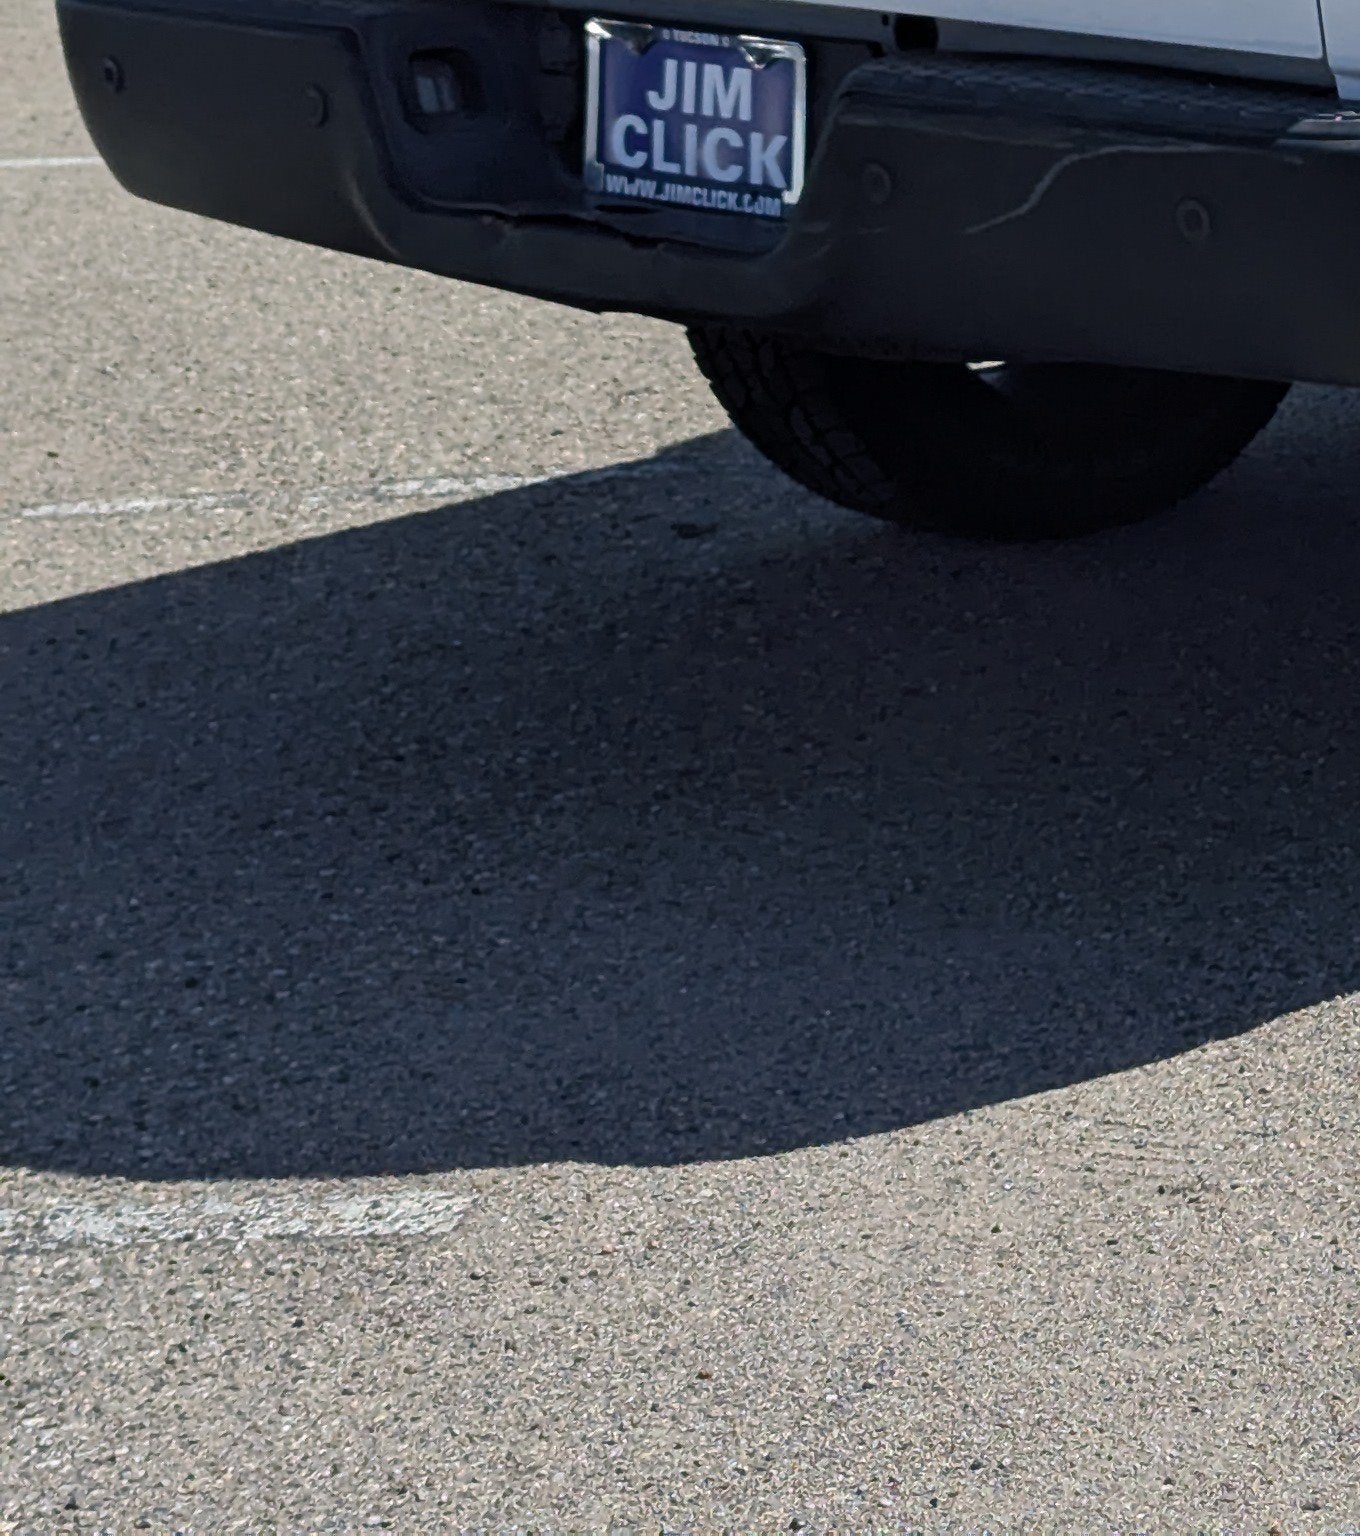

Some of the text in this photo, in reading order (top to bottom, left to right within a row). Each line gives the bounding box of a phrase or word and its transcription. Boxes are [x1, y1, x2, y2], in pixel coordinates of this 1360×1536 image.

[646, 58, 752, 121] JIM
[611, 114, 787, 189] CLICK
[606, 173, 781, 218] WWW.JIMCLICK.COM
